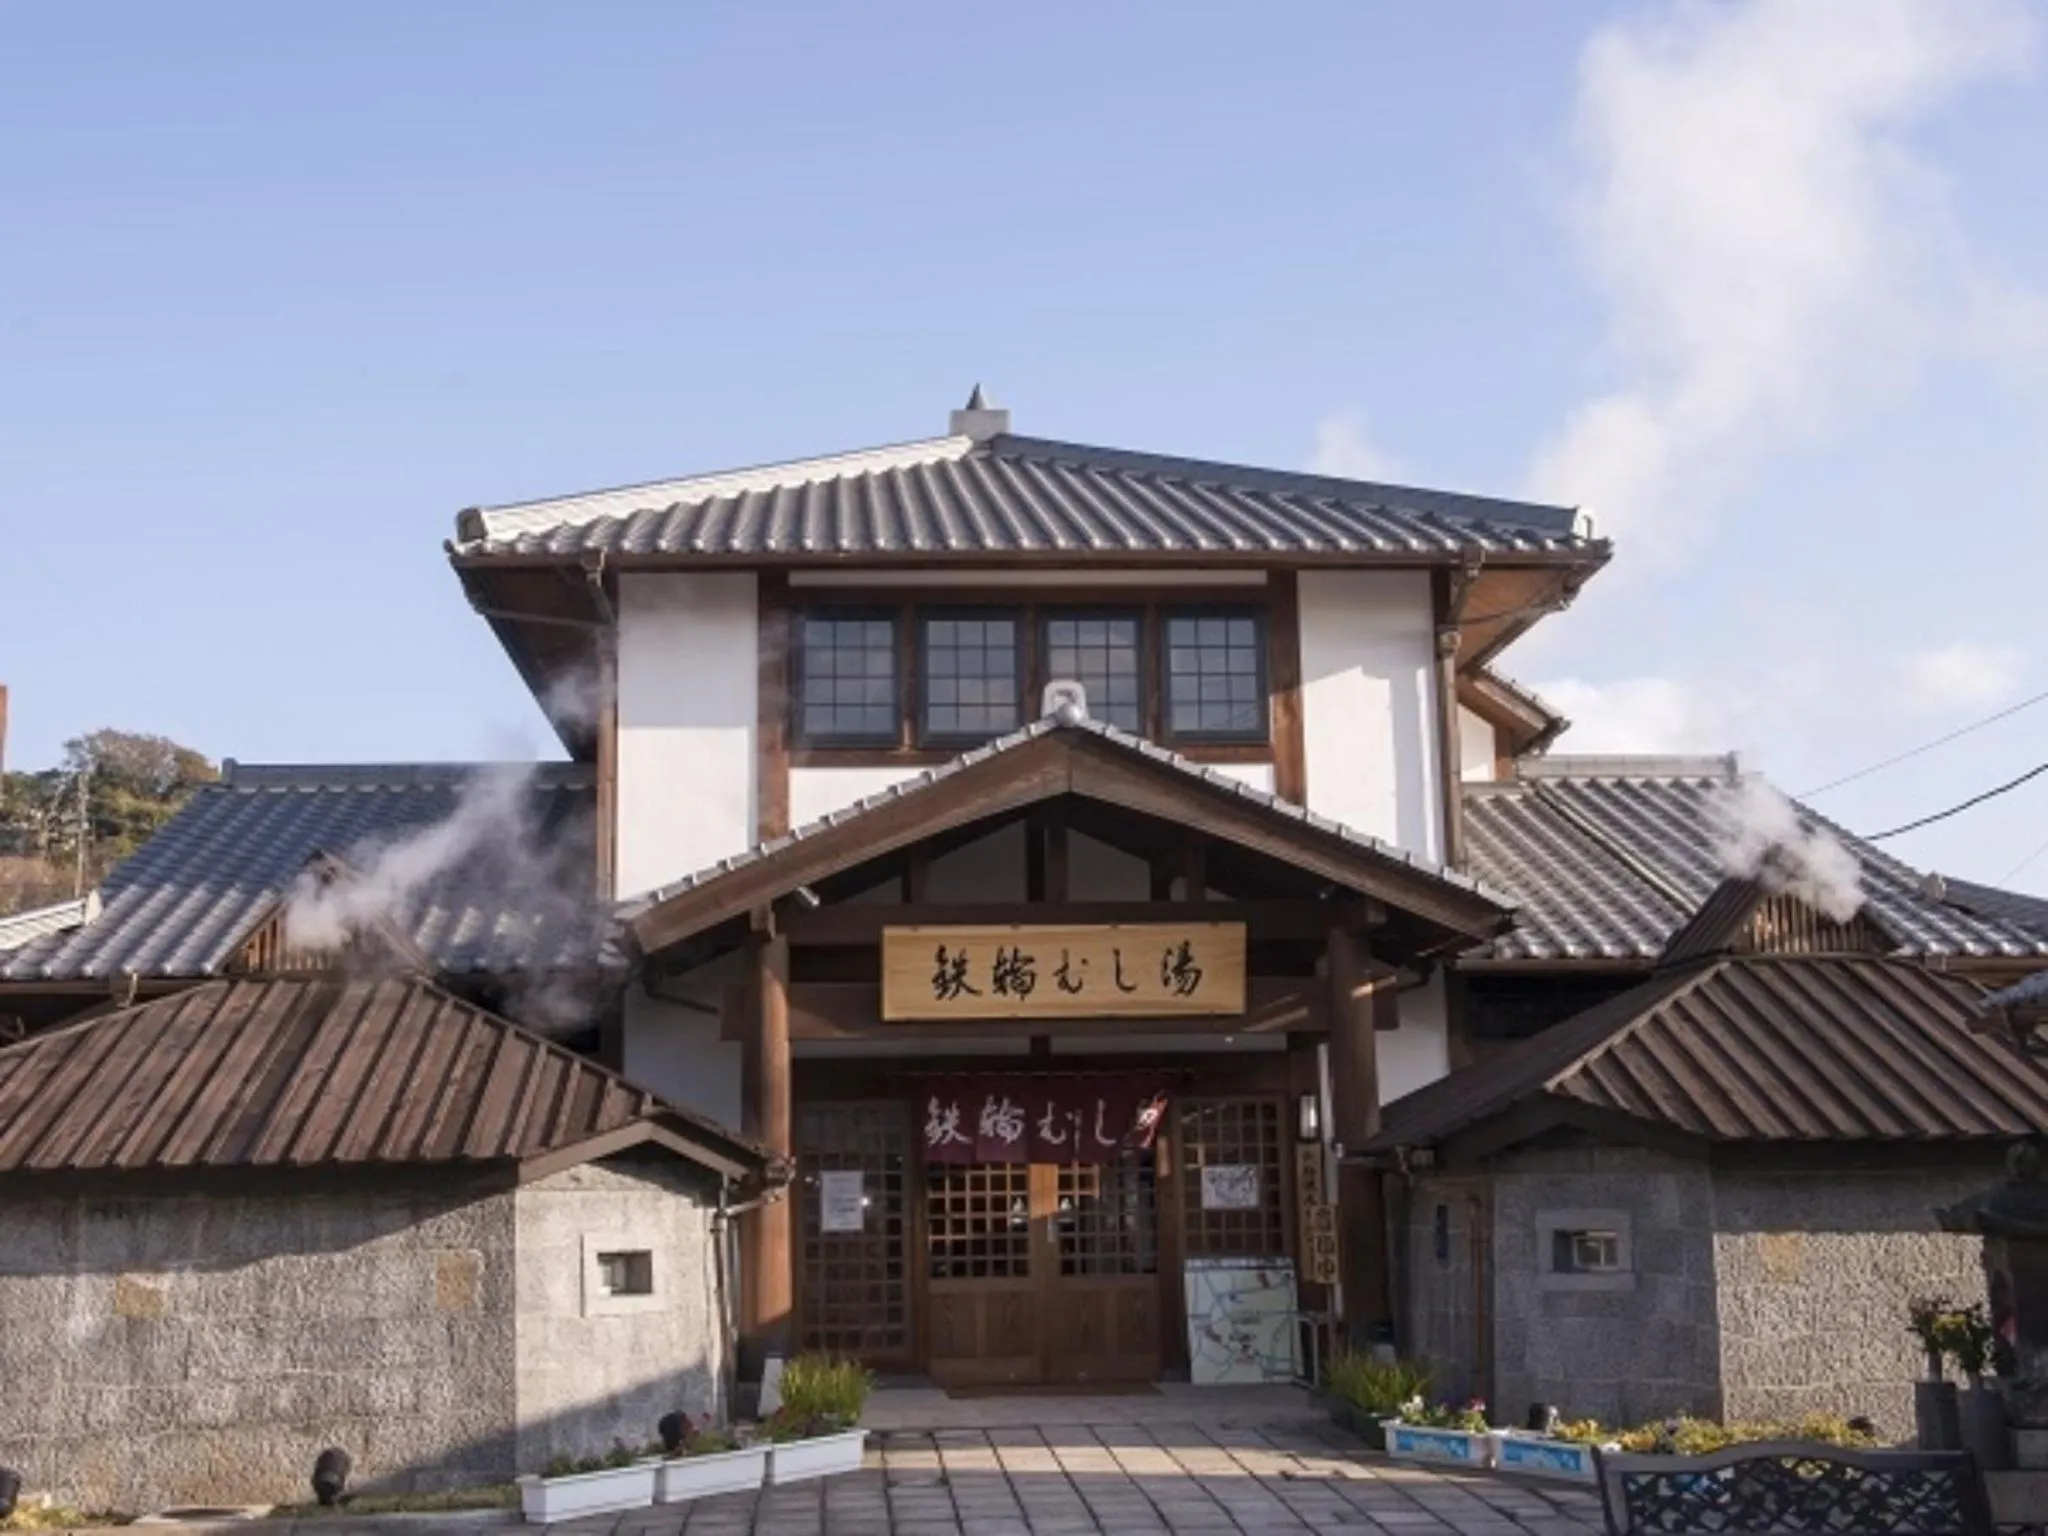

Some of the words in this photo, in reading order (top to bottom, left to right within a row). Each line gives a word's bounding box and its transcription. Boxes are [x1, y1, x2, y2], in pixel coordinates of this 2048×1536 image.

[931, 940, 1203, 1003] 鉄輪むし湯
